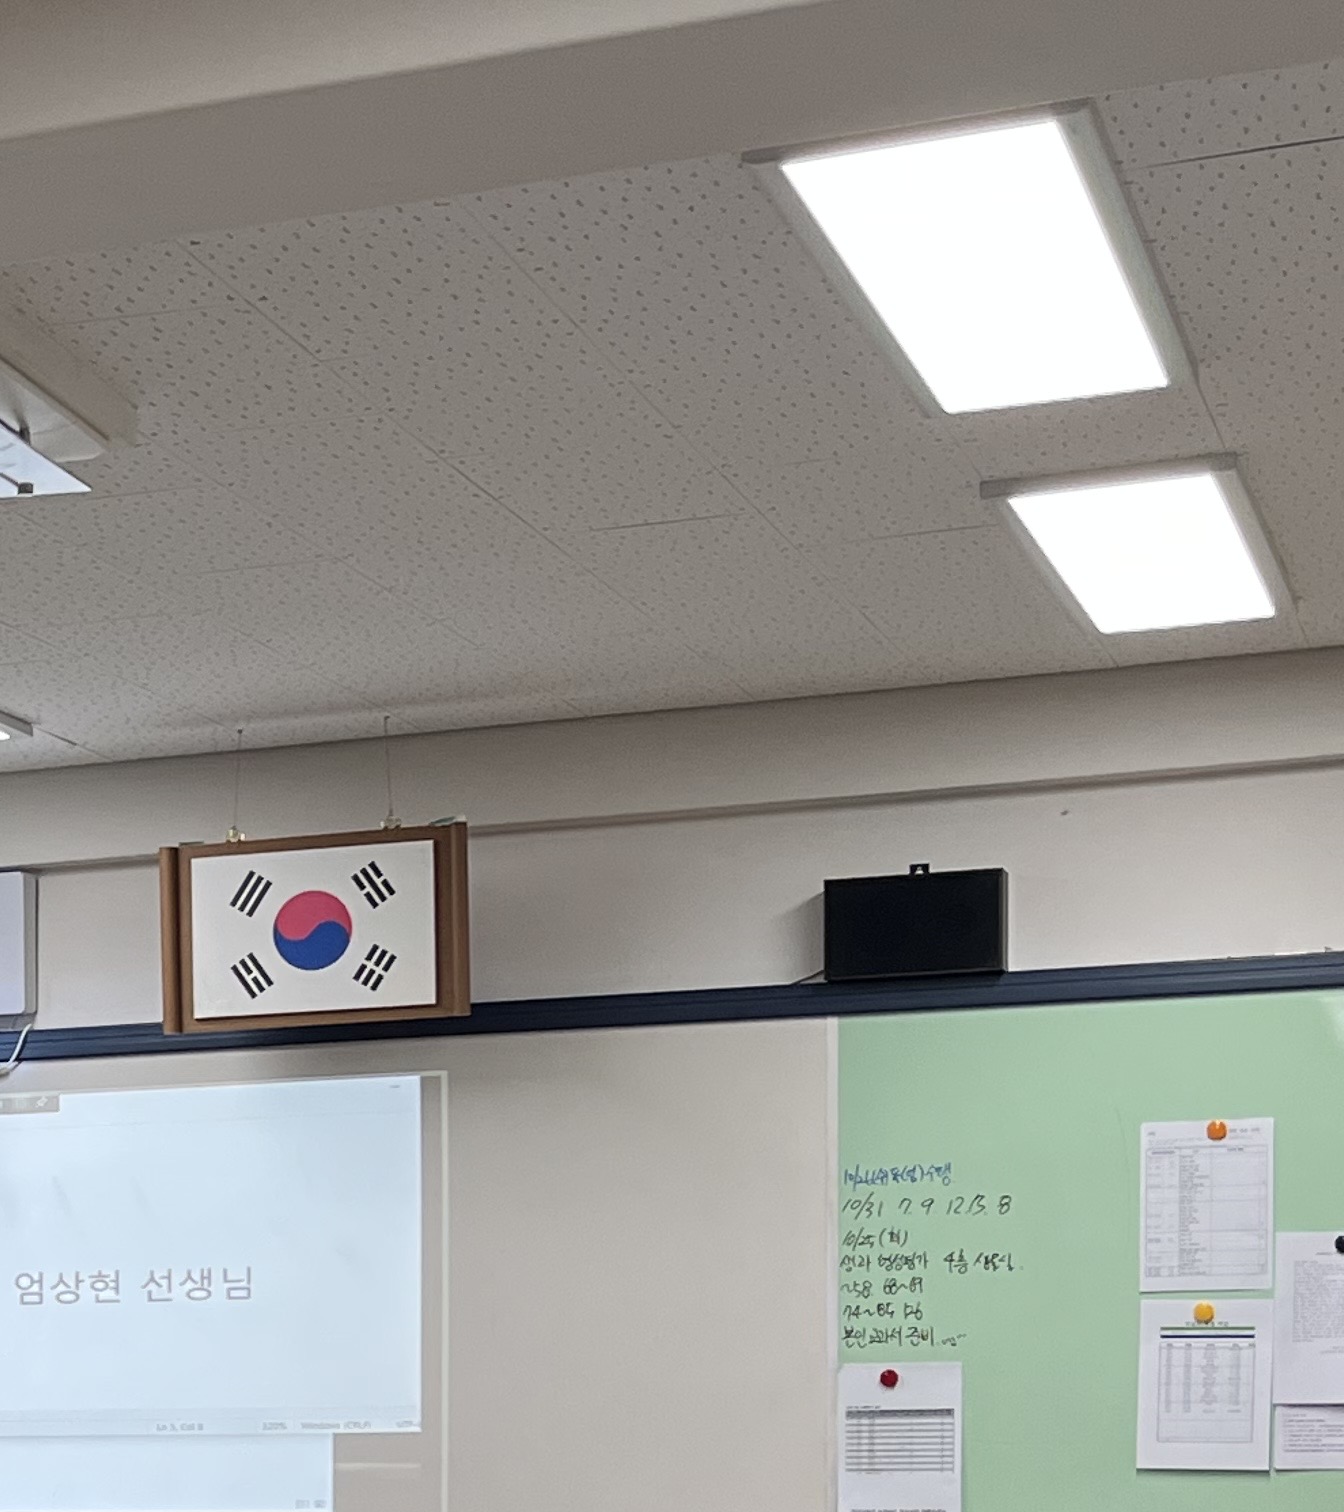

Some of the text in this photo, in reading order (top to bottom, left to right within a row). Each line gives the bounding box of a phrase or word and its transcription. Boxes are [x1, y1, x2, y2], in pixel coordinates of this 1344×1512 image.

[841, 1191, 883, 1220] 10/31
[14, 1265, 253, 1306] 엄상현 선생님
